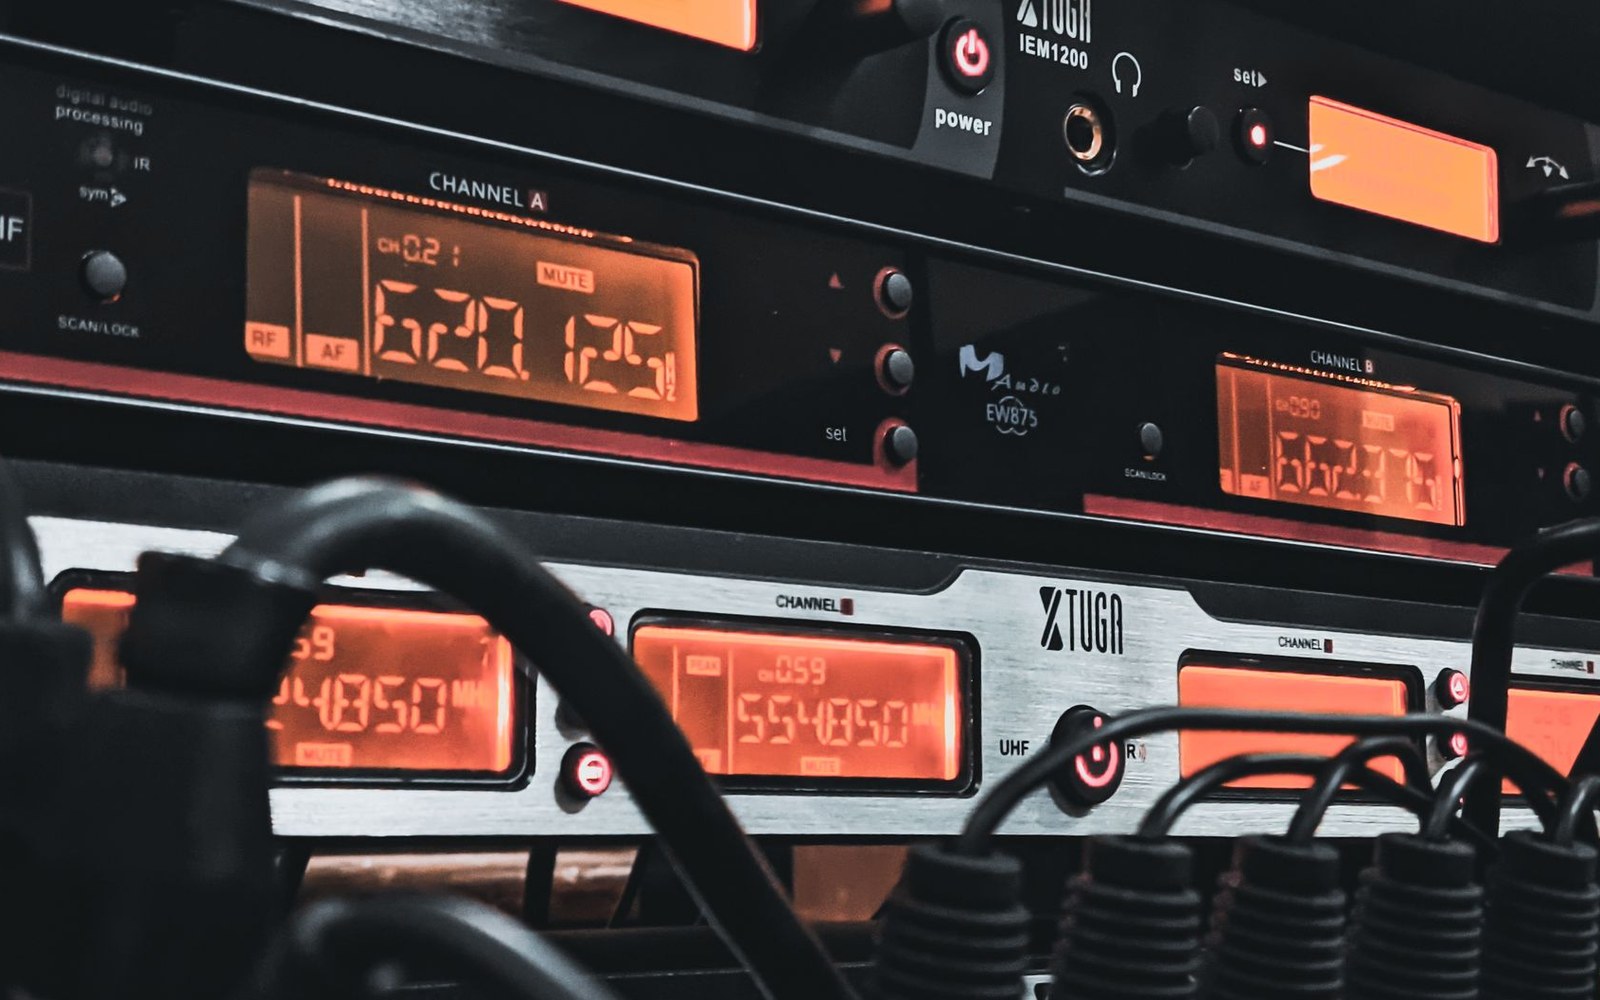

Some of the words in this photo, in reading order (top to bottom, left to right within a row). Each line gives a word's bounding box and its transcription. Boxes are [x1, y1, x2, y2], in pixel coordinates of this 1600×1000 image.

[1019, 33, 1089, 70] IEM1200
[1233, 67, 1257, 87] set
[55, 105, 144, 137] processing
[935, 107, 992, 136] power
[134, 157, 151, 171] IR
[429, 172, 524, 208] CHANNEL
[531, 193, 545, 211] A
[543, 267, 588, 289] MUTE
[58, 315, 140, 338] SCAN/LOCK
[251, 329, 277, 348] RF
[321, 342, 345, 360] AF
[1310, 350, 1362, 373] CHANNEL
[986, 402, 1038, 428] EW875
[775, 594, 840, 613] CHANNEL
[1039, 586, 1124, 655] XTUGA
[1278, 635, 1323, 651] CHANNEL
[999, 739, 1030, 756] UHF
